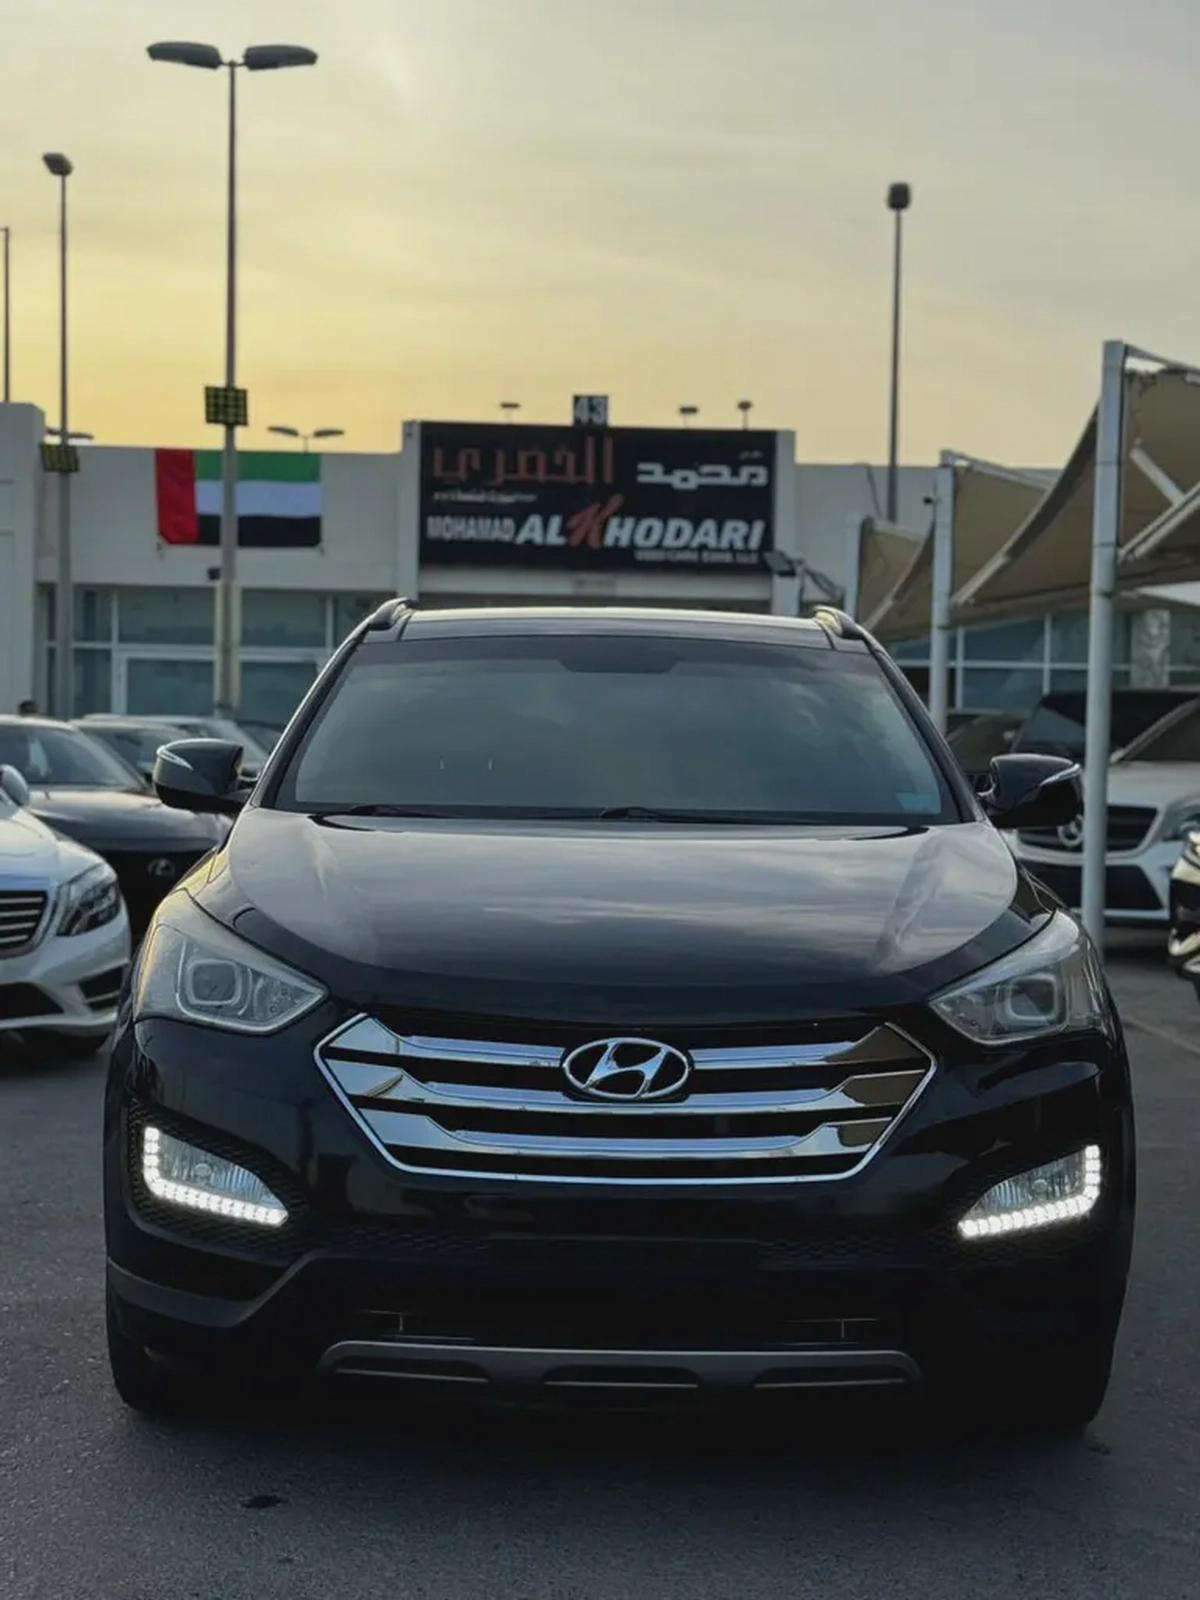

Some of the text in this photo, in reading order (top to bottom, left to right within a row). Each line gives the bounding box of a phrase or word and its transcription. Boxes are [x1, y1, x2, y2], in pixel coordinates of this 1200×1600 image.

[575, 397, 606, 423] 43
[635, 461, 769, 490] محمد
[514, 513, 567, 546] AL
